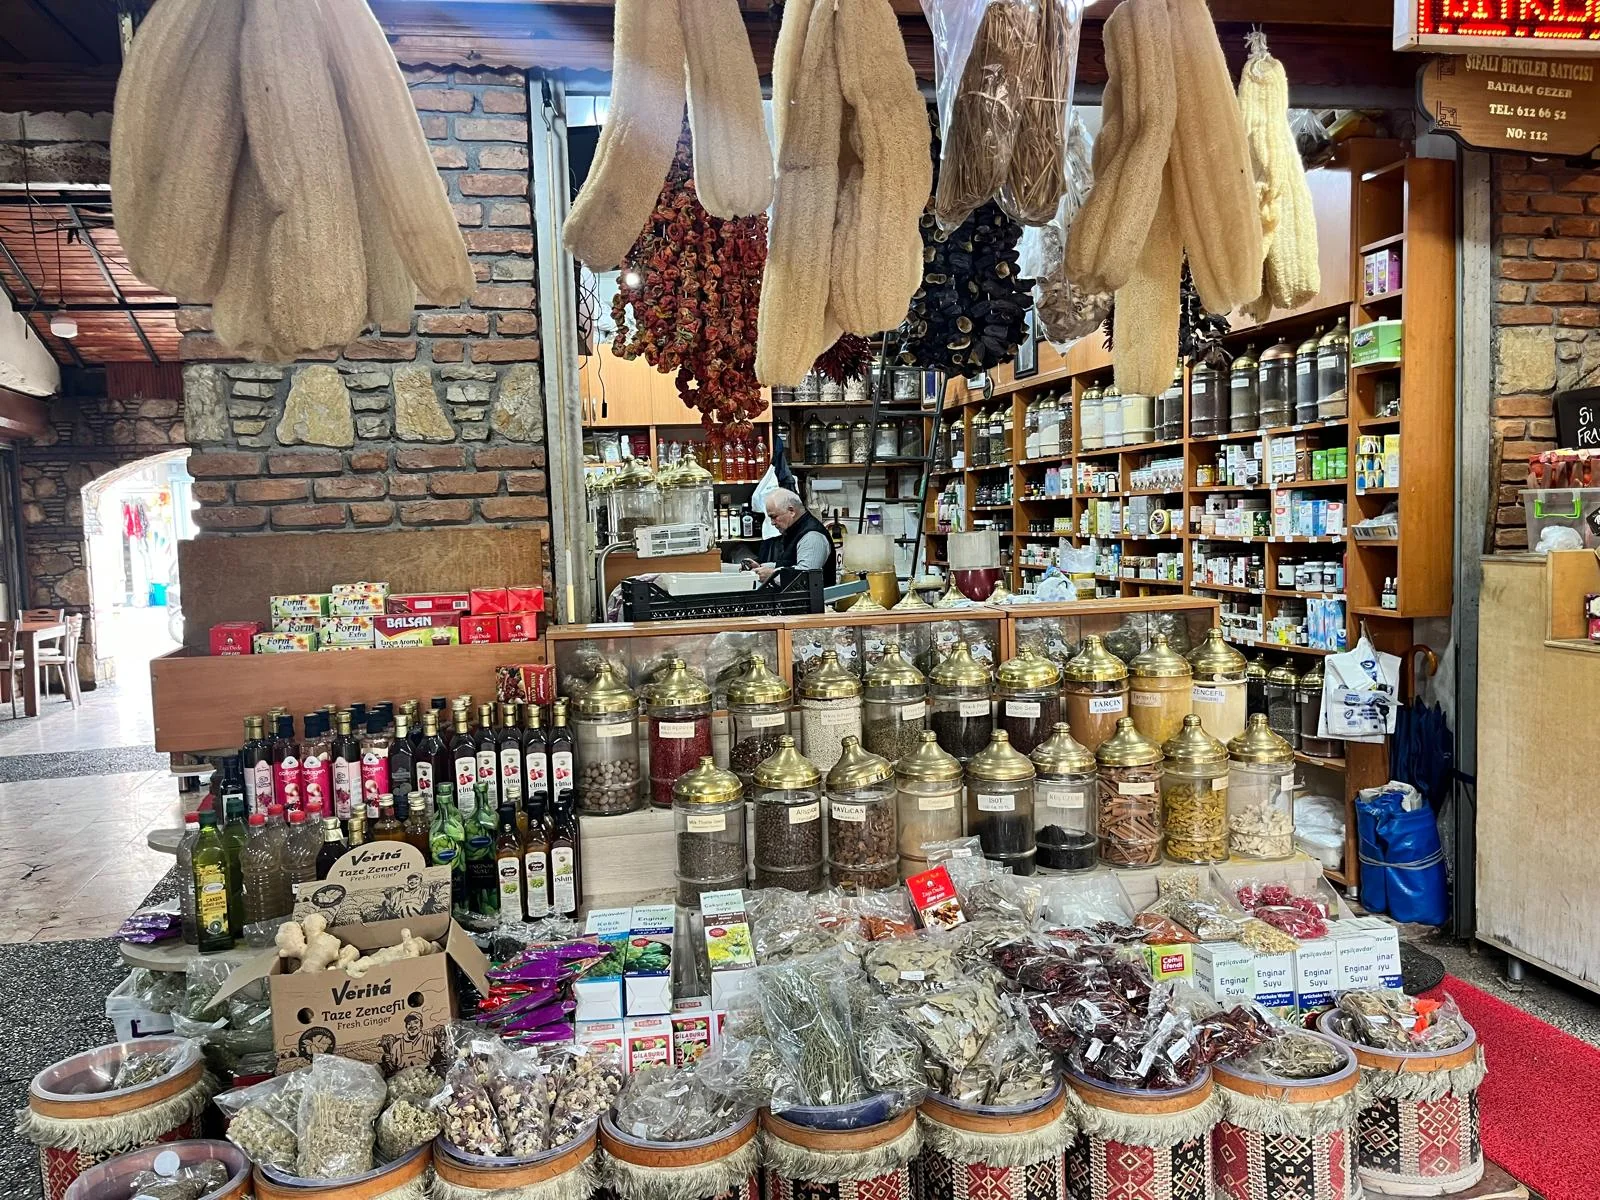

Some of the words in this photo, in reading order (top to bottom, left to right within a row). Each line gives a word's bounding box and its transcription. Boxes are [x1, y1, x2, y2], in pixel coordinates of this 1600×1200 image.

[1536, 86, 1573, 99] GEZER
[1489, 103, 1514, 116] TEL:
[1516, 105, 1536, 118] 612
[1538, 107, 1551, 119] 66
[1554, 110, 1567, 121] 52
[1505, 127, 1526, 139] NO:
[1529, 130, 1548, 141] 112
[342, 598, 365, 606] Form
[386, 616, 432, 628] BALSAN
[288, 623, 314, 632] Form
[335, 623, 361, 633] Form
[266, 637, 290, 645] Form
[529, 781, 547, 789] elma
[351, 848, 403, 867] Veritá
[339, 868, 366, 878] Taze
[368, 862, 411, 874] Zencefil
[349, 873, 371, 883] Fresh
[1257, 969, 1286, 979] Enginar
[1304, 969, 1333, 979] Enginar
[1344, 964, 1374, 974] Enginar
[1220, 976, 1249, 987] Enginar
[1263, 980, 1282, 988] Suyu
[1309, 979, 1328, 987] Suyu
[1350, 975, 1368, 983] Suyu
[331, 977, 392, 1006] Veritá
[1225, 987, 1245, 996] Suyu
[321, 1009, 352, 1022] Taze
[355, 999, 406, 1018] Zencefil
[336, 1019, 361, 1030] Fresh
[363, 1015, 392, 1028] Ginger
